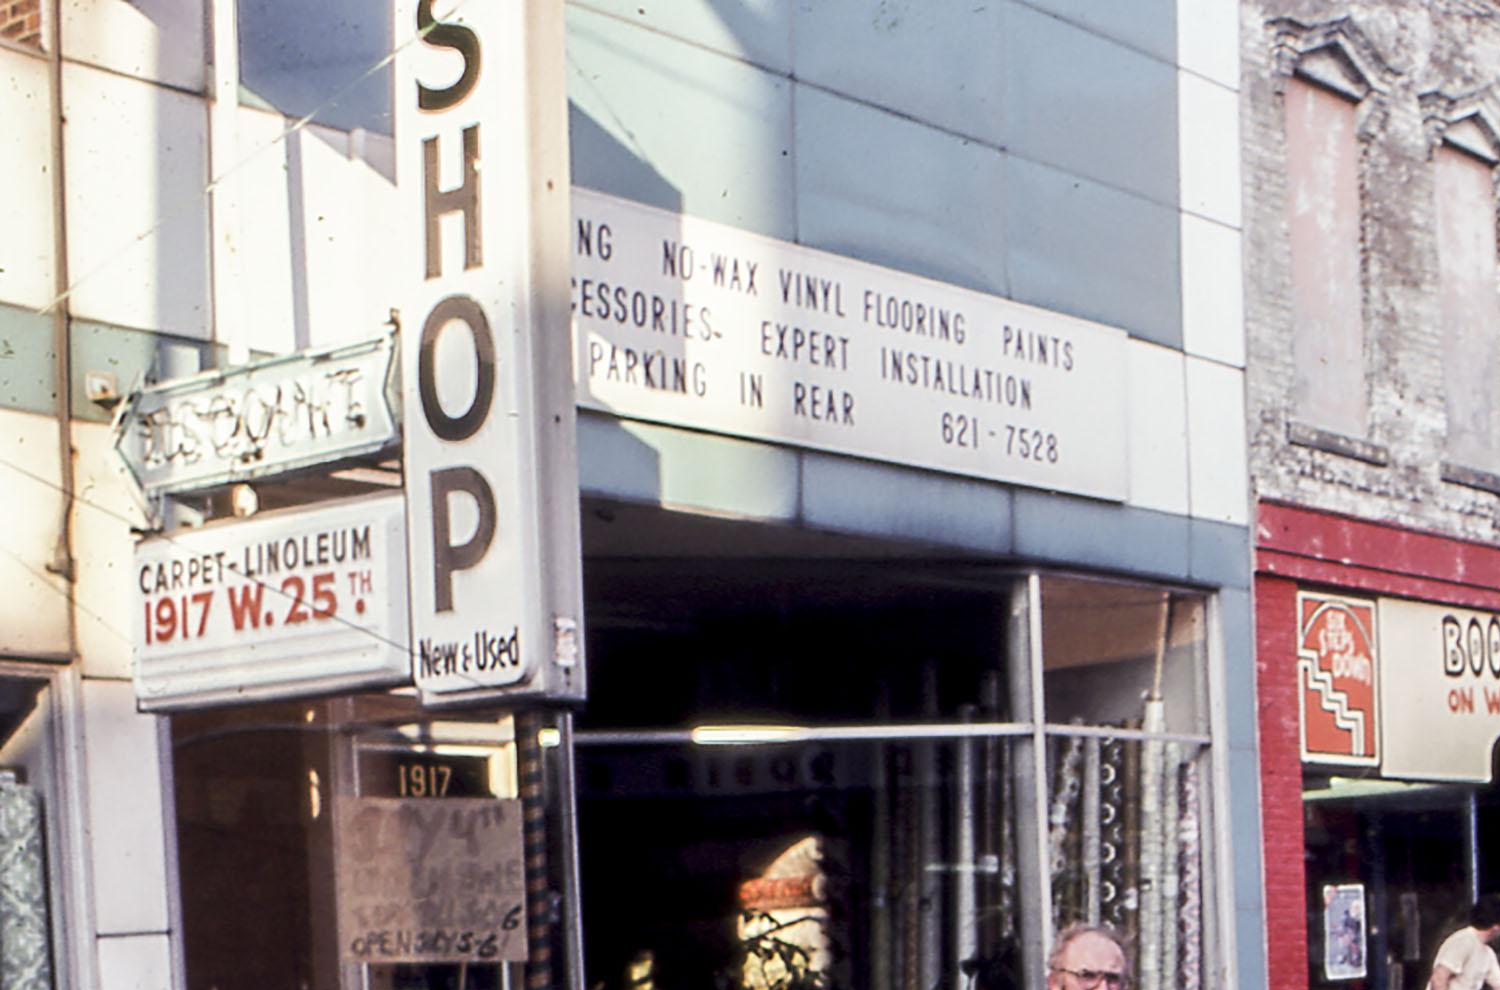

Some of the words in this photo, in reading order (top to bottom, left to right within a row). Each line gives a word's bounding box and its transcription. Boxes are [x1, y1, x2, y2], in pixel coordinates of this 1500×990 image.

[416, 0, 498, 615] SHOP
[578, 219, 612, 261] NG
[663, 239, 758, 297] NO-WAX
[779, 268, 845, 318] VINYL
[864, 290, 966, 344] FLOORING
[1003, 325, 1074, 371] PAINTS
[761, 320, 849, 371] EXPERT
[882, 346, 1032, 410] INSTALLATION
[590, 340, 707, 398] PARKING
[740, 370, 763, 409] IN
[794, 381, 855, 426] REAR
[941, 411, 1060, 464] 621-7528
[144, 591, 215, 645] 1917
[228, 582, 275, 632] W.
[420, 638, 458, 679] New
[474, 626, 520, 672] Used
[1448, 688, 1473, 714] ON
[399, 763, 453, 798] 1917
[351, 929, 413, 957] OPEN
